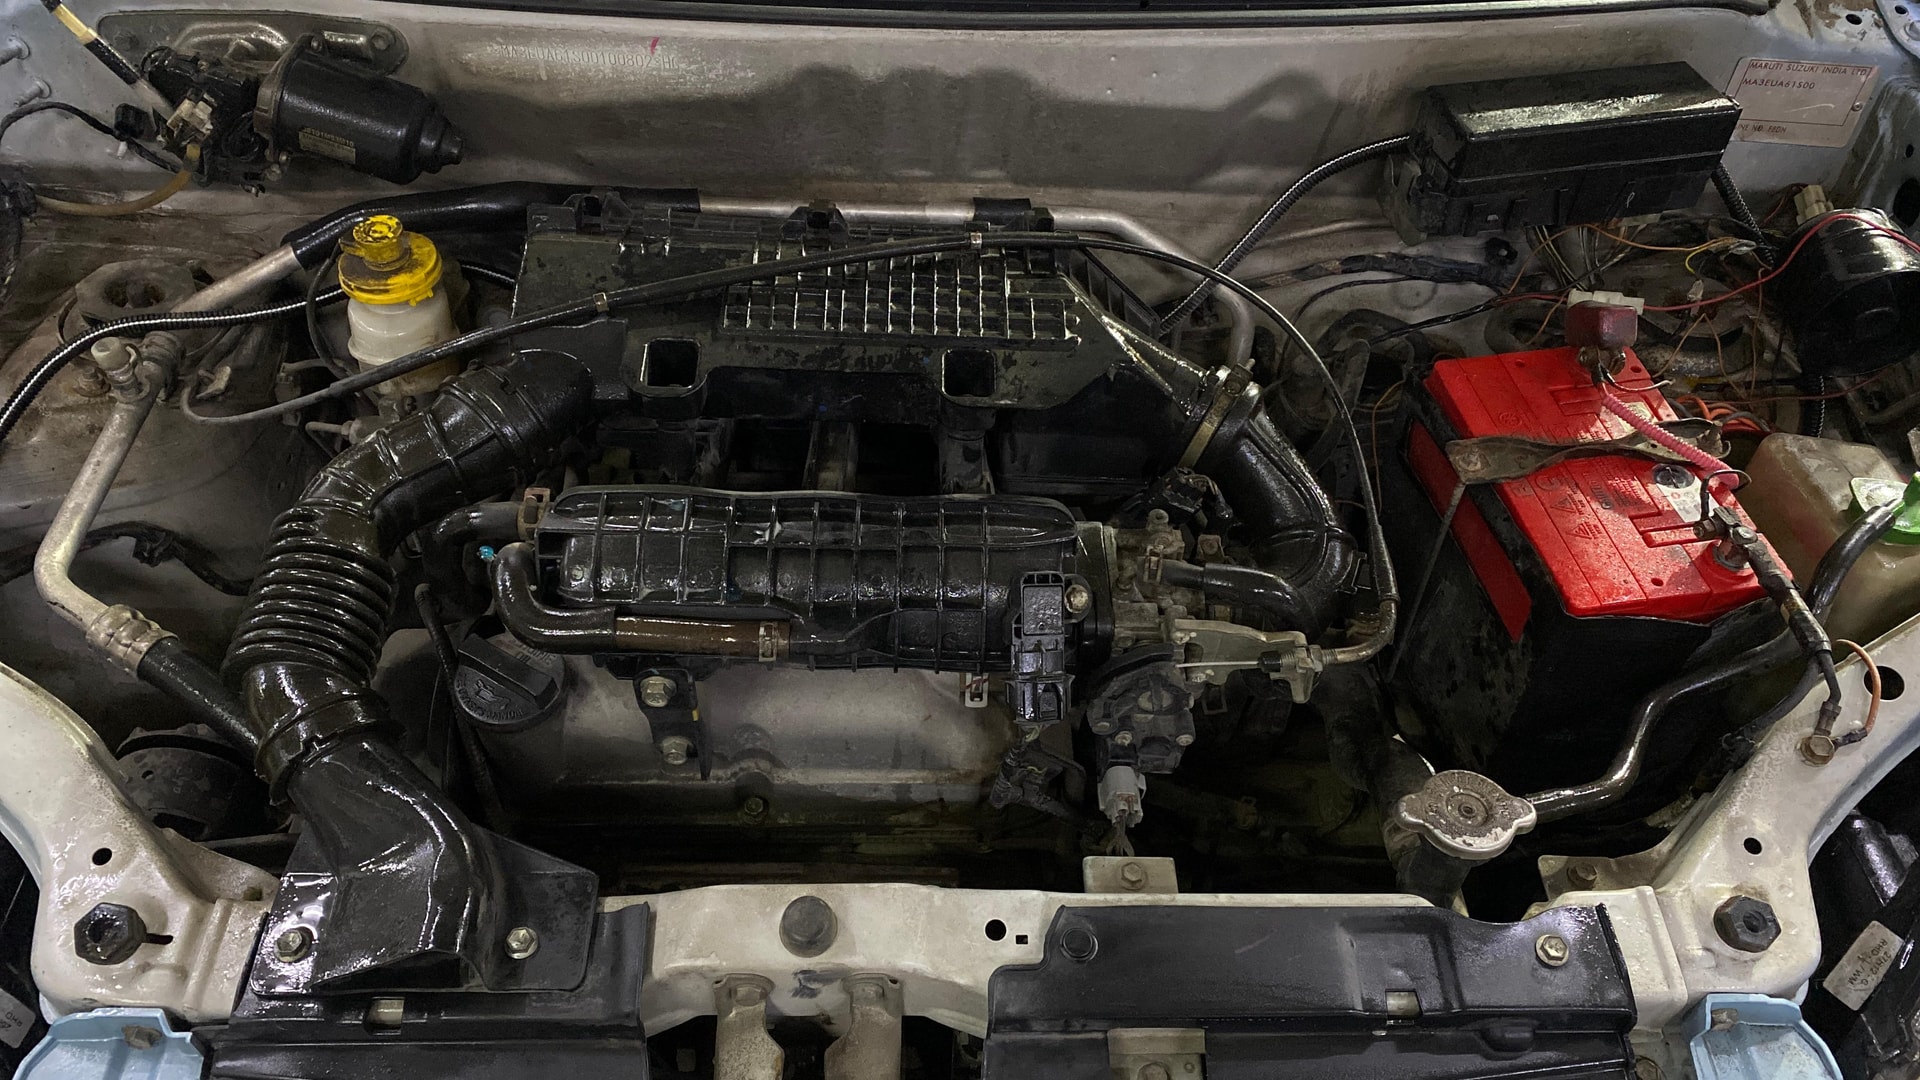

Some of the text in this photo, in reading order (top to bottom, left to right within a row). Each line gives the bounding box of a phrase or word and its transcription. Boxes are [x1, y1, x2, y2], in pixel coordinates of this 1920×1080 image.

[1750, 61, 1784, 70] MARUTI
[1786, 63, 1819, 73] SUZUKI
[1822, 65, 1847, 75] INDIA
[1742, 78, 1816, 90] MA3EUA61S00
